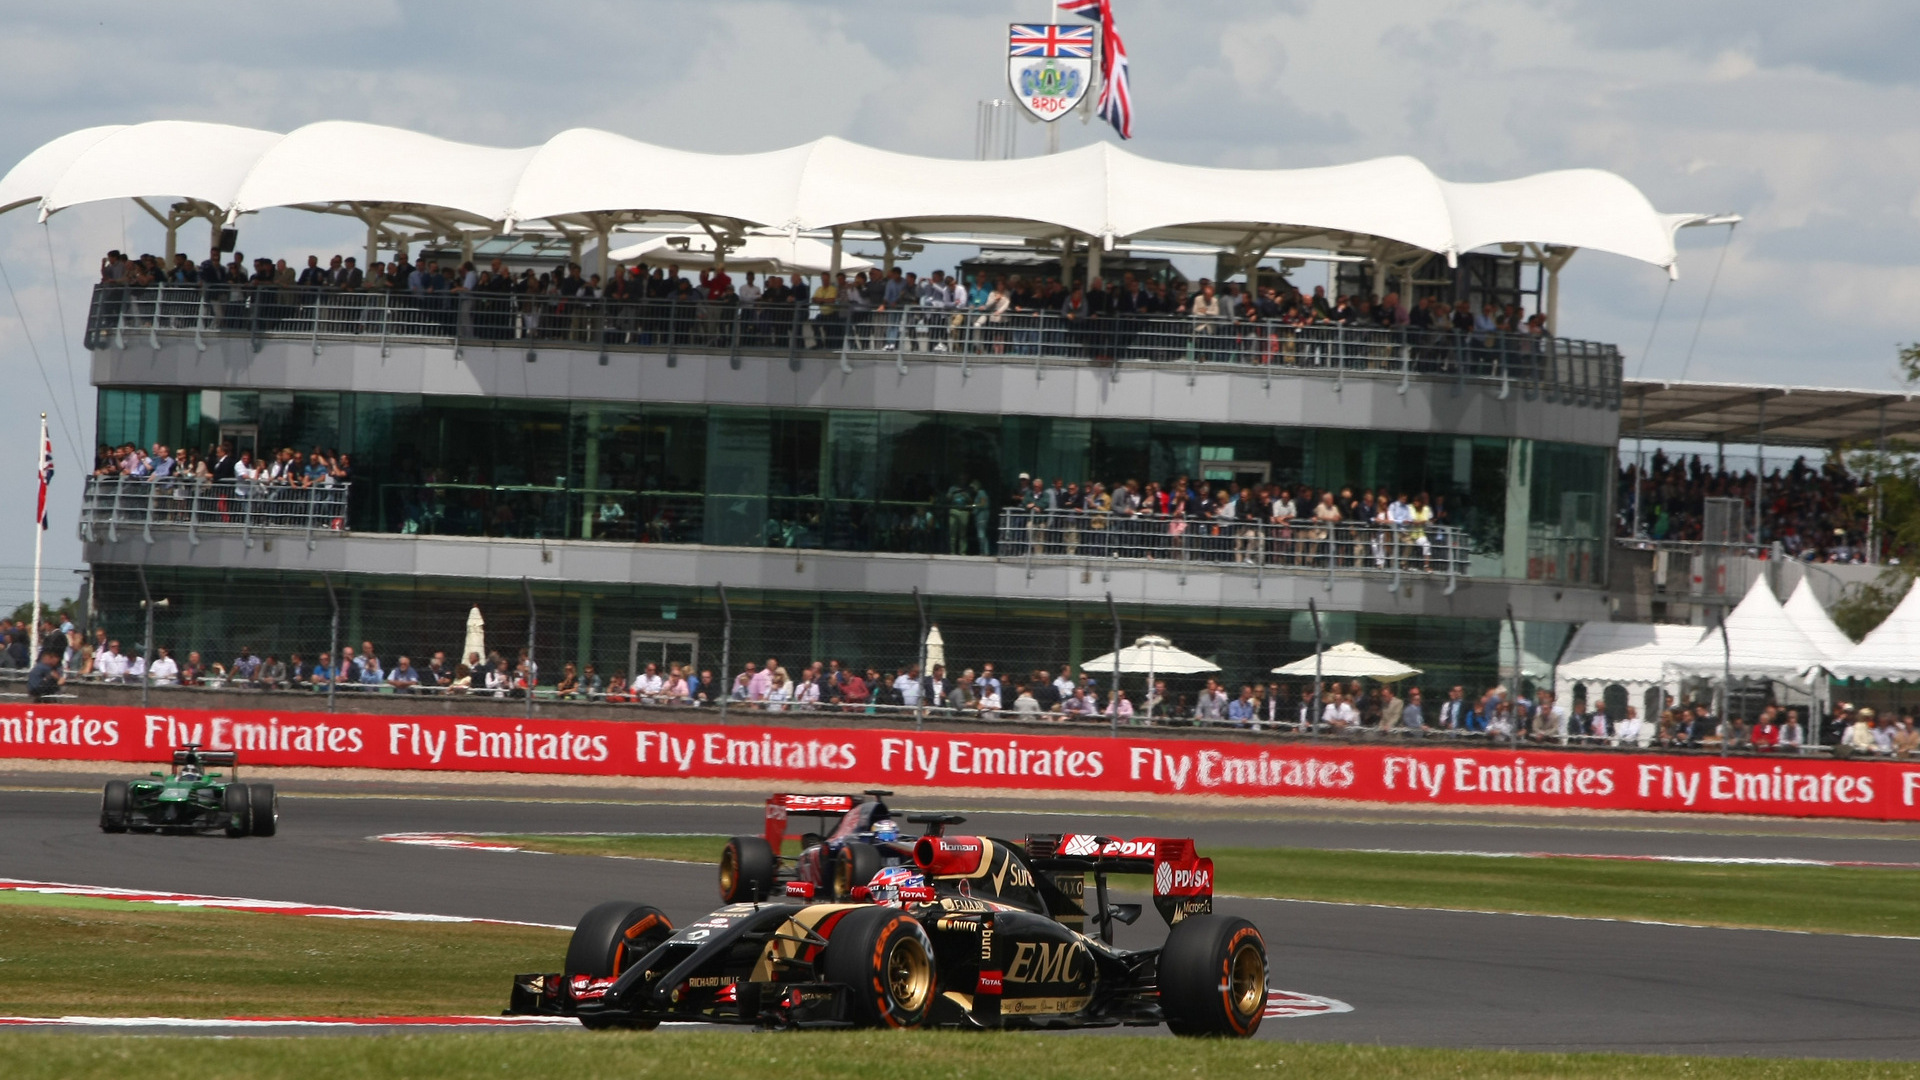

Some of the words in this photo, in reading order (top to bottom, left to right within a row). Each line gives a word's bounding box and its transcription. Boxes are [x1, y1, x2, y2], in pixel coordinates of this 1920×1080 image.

[1032, 97, 1067, 112] BRDC
[211, 717, 363, 753] Emirates
[388, 723, 447, 764] Fly
[455, 723, 608, 762] Emirates
[635, 730, 696, 771] Fly
[703, 732, 857, 770] Emirates
[880, 738, 940, 780] Fly
[948, 740, 1104, 778] Emirates
[1130, 747, 1192, 791] Fly
[1196, 750, 1355, 788] Emirates
[1383, 756, 1446, 797] Fly
[1453, 757, 1614, 796] Emirates
[1638, 764, 1700, 806] Fly
[1709, 765, 1874, 804] Emirates
[940, 841, 978, 852] Romain
[900, 890, 928, 898] TOTAL
[1174, 870, 1210, 888] PDVSA
[981, 929, 994, 960] burn
[1003, 941, 1086, 983] EMC
[689, 977, 719, 988] RICHARD
[980, 977, 1002, 986] TOTAL
